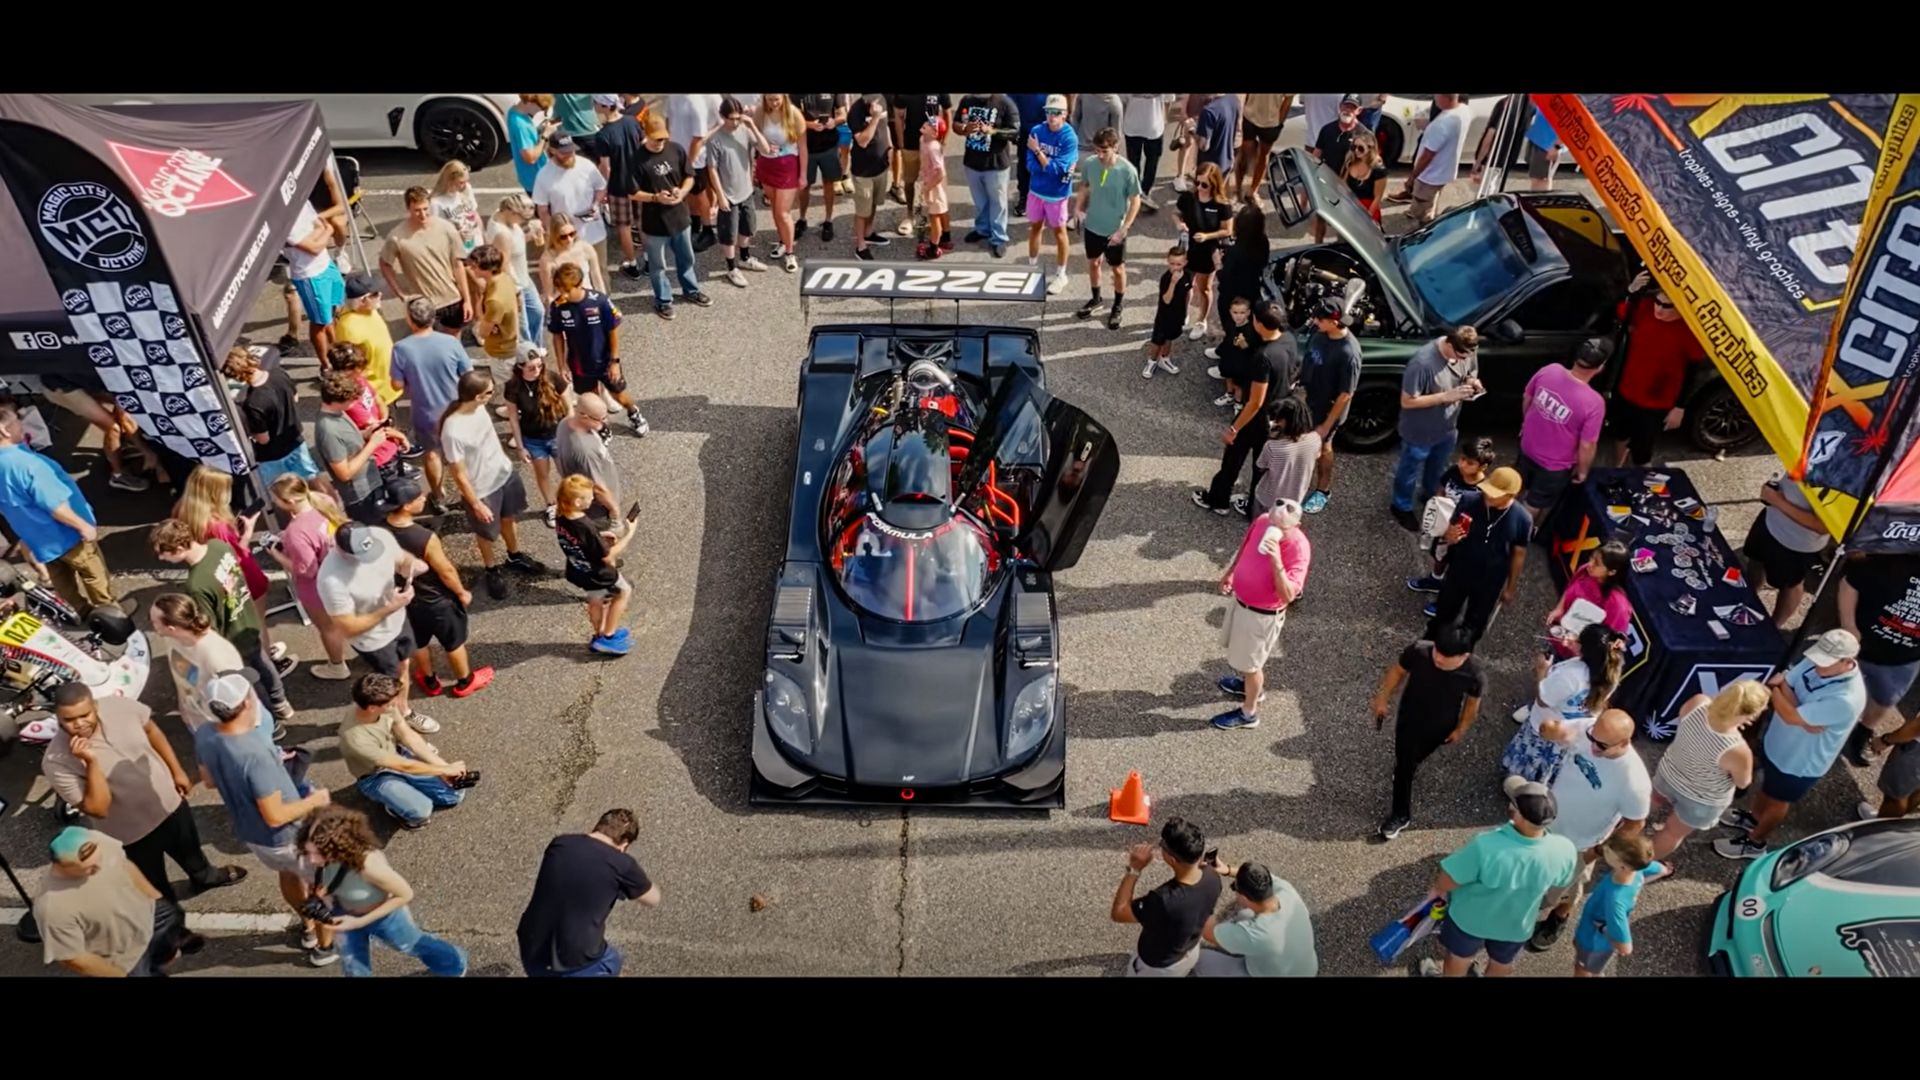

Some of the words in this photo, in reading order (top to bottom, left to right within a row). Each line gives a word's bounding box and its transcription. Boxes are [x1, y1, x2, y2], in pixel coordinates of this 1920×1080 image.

[42, 186, 72, 222] MAGIC
[69, 184, 108, 198] CITY
[1678, 148, 1713, 188] trophies
[1711, 188, 1739, 219] signs
[1738, 222, 1767, 252] vinyl
[1756, 248, 1806, 300] graphics
[98, 241, 145, 269] OCTANE
[803, 266, 1043, 295] MAZZEI
[1696, 300, 1769, 398] Graphics
[866, 512, 934, 540] FORMULA
[1742, 898, 1758, 917] 00
